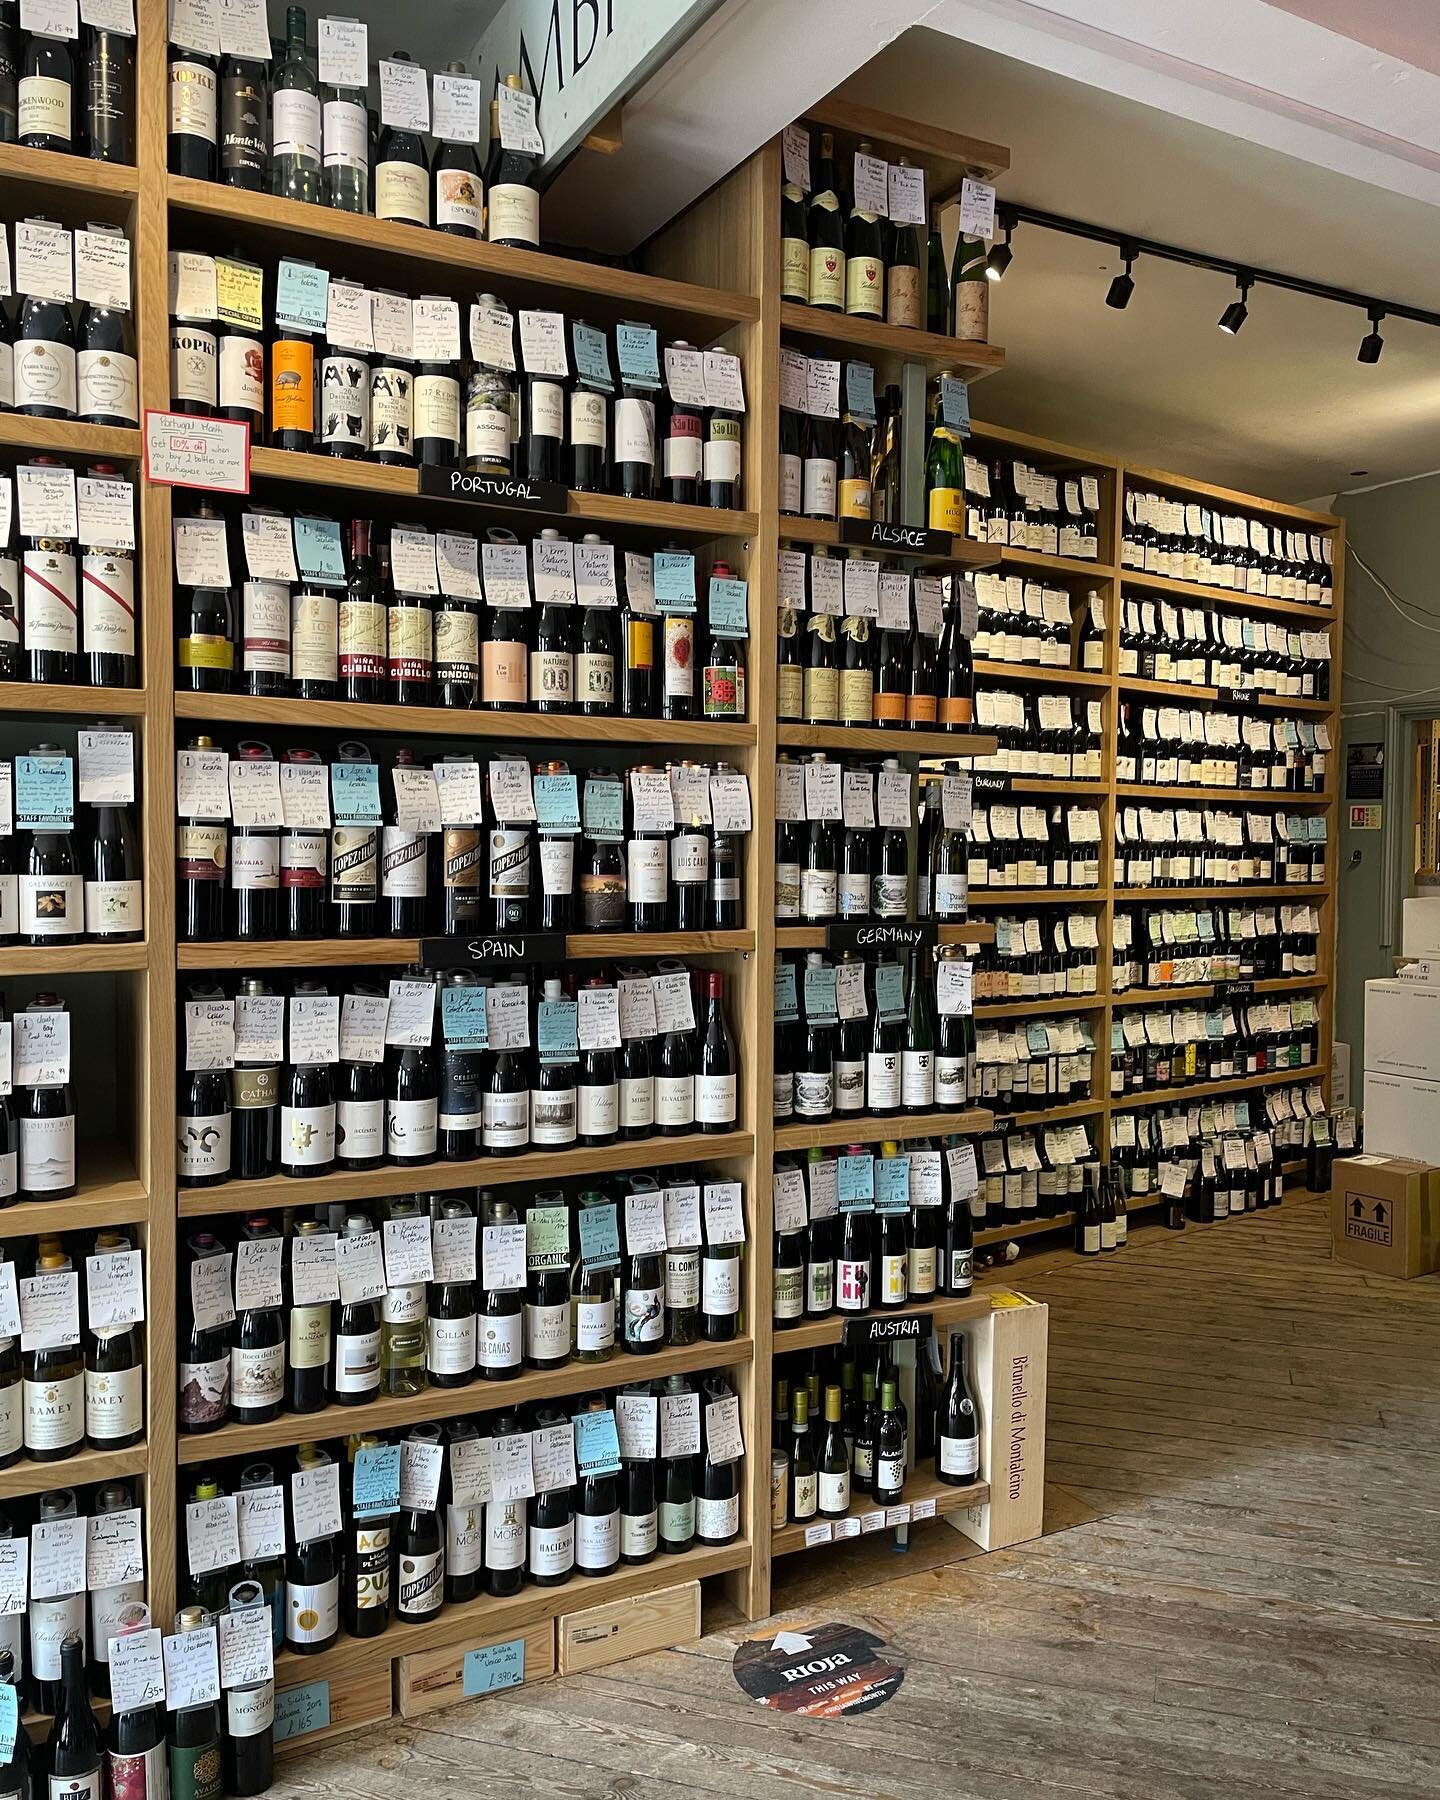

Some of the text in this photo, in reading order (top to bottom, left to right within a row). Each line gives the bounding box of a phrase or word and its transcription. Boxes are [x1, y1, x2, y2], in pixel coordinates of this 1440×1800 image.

[223, 133, 253, 147] Monte
[218, 307, 261, 325] SPECIAL OFFER
[160, 416, 224, 435] Portugal Month
[151, 436, 167, 448] Get
[172, 439, 190, 450] 10%
[211, 446, 230, 454] when
[185, 454, 193, 463] 2
[194, 455, 215, 464] bottles
[165, 462, 200, 478] Portuguese
[450, 471, 542, 500] PORTUGAL
[871, 523, 928, 547] ALSACE
[342, 664, 384, 675] CUBILLO
[353, 657, 374, 665] VIÑA
[402, 661, 422, 669] VIÑA
[451, 663, 470, 671] VIÑA
[390, 668, 431, 679] CUBILLO
[19, 814, 72, 823] STAFF FAVOURITE
[234, 859, 264, 867] NAVAJAS
[334, 850, 358, 874] LOPEZ
[384, 851, 406, 872] LOPEZ
[448, 853, 472, 874] LOPEZ
[492, 853, 516, 874] LOPEZ
[856, 927, 923, 946] GERMANY
[467, 940, 525, 960] SPAIN
[1347, 1223, 1390, 1243] FRAGILE
[528, 1253, 567, 1267] ORGANIC
[668, 1261, 677, 1271] EL
[436, 1328, 470, 1339] CILLAR
[869, 1319, 921, 1340] AUSTRIA
[29, 1402, 73, 1417] RAMEY
[1008, 1355, 1028, 1500] Brunello di Montalcino
[493, 1526, 524, 1540] MORO
[402, 1577, 426, 1599] LOPEZ
[808, 1672, 862, 1695] THIS WAY
